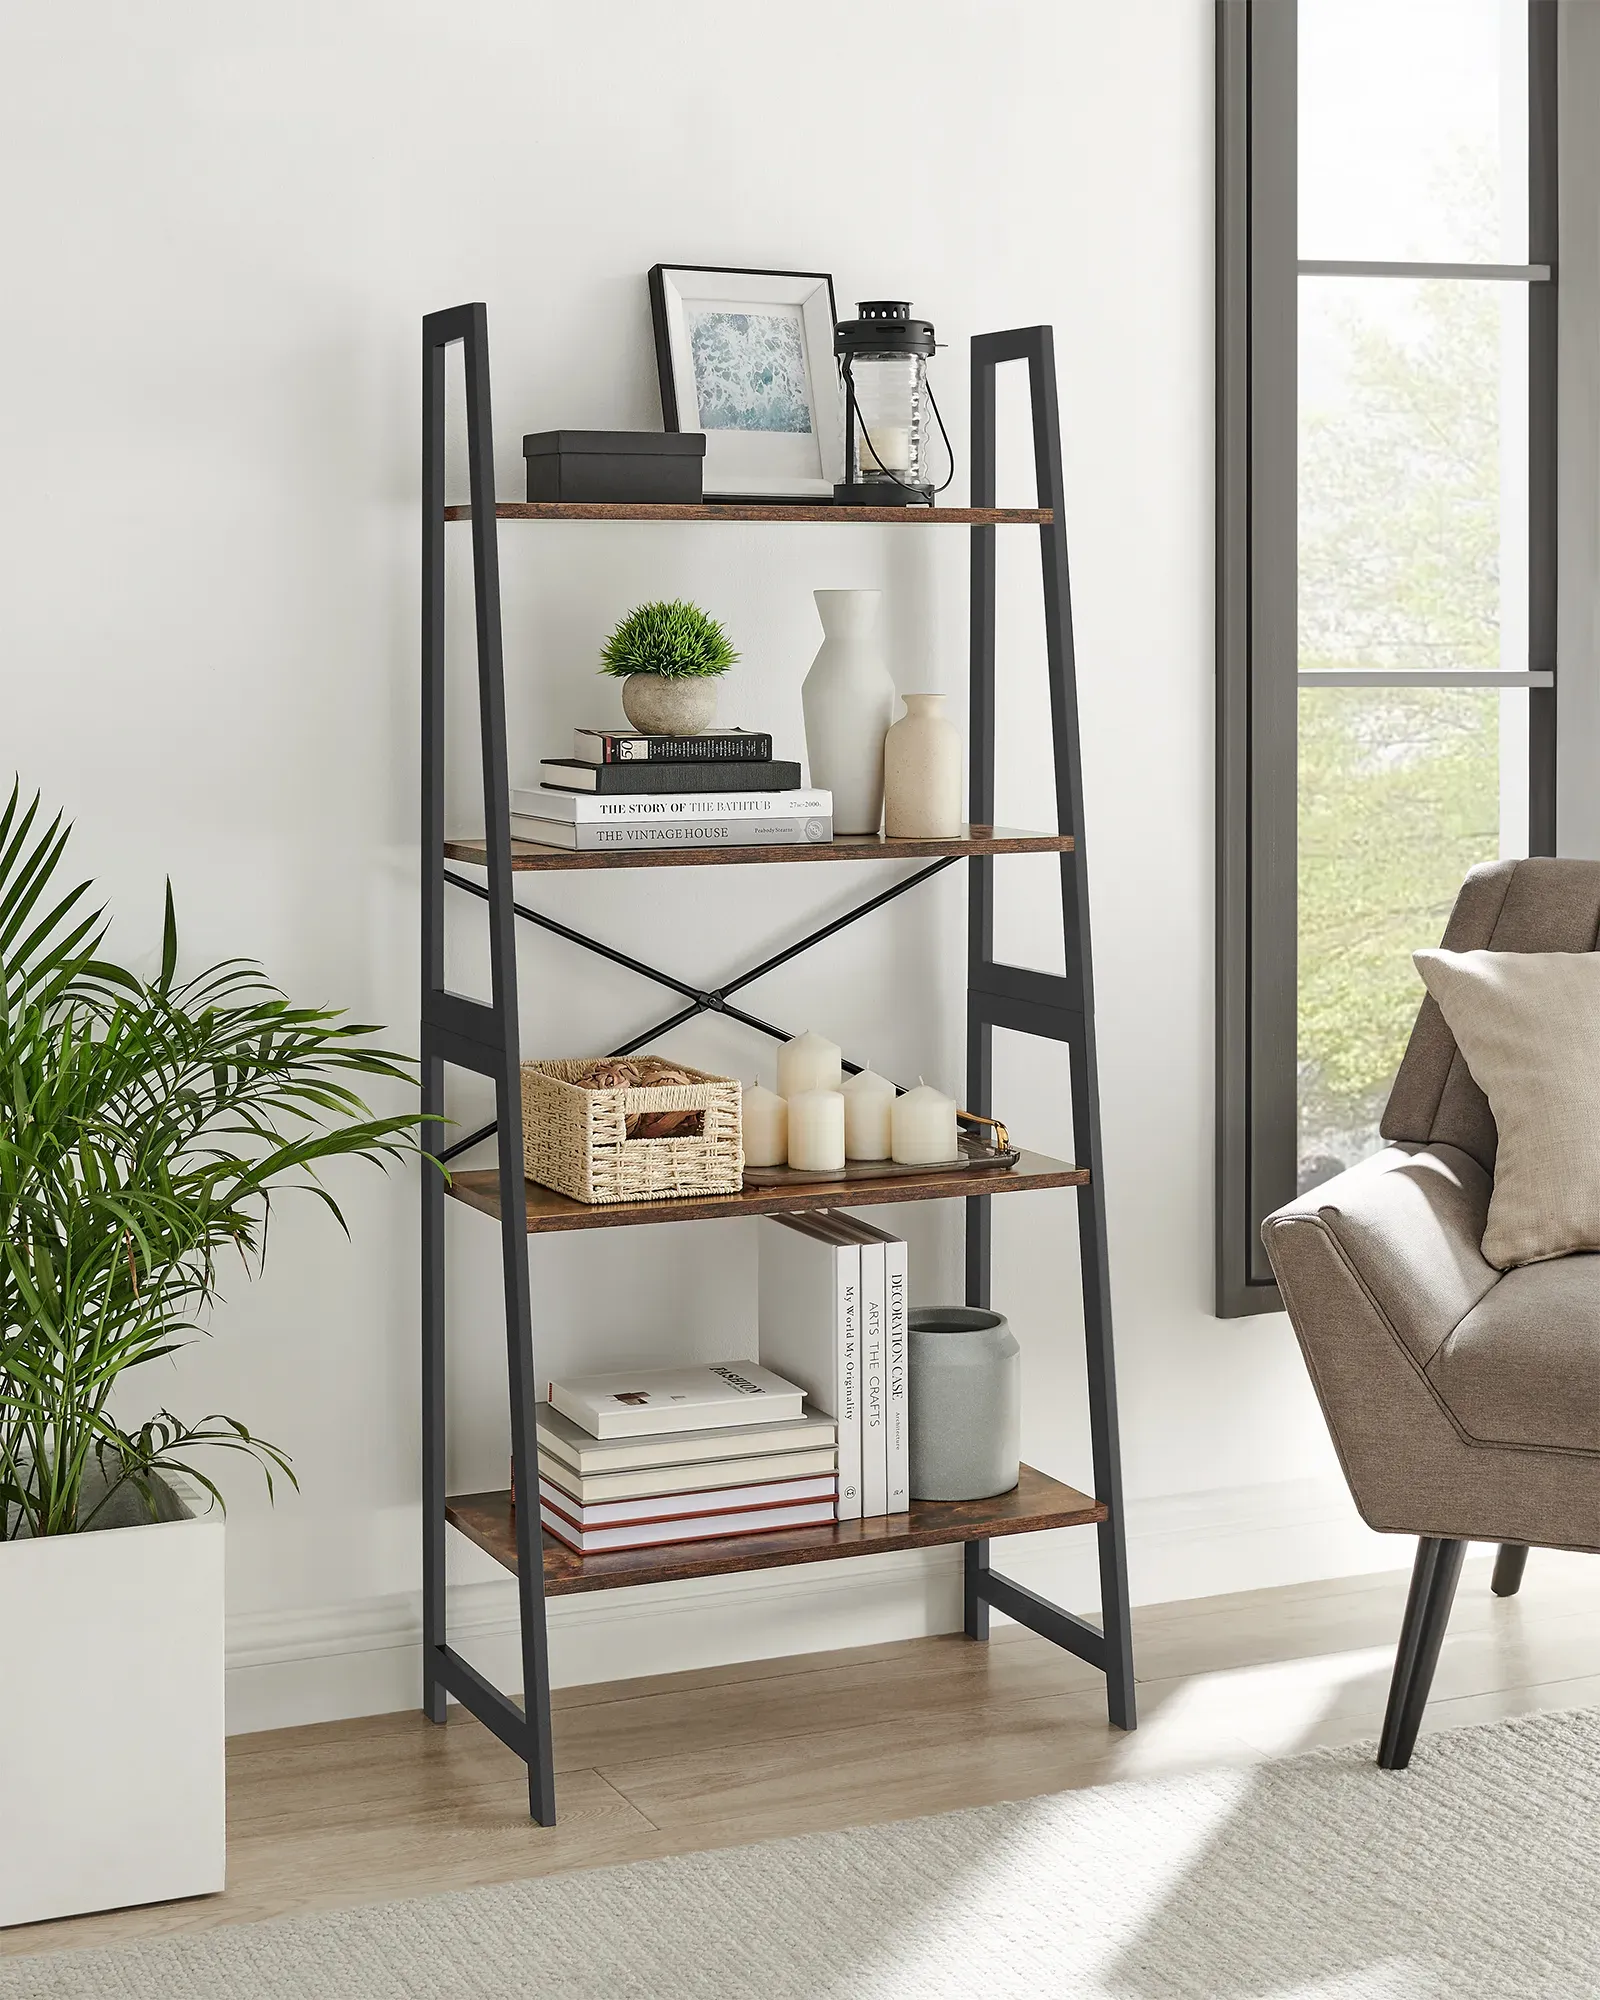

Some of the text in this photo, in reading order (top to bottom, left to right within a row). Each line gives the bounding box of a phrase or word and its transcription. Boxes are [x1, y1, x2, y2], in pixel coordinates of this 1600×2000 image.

[622, 740, 634, 760] 50
[599, 801, 771, 814] THE STORY OF THE BATHTUB
[596, 828, 729, 841] THE VINTAGE HOUSE
[891, 1274, 903, 1401] DECORATION CASE
[844, 1286, 855, 1420] My World My Originality
[868, 1301, 880, 1428] ARTS THE CRAFTS
[709, 1367, 766, 1394] FASHION
